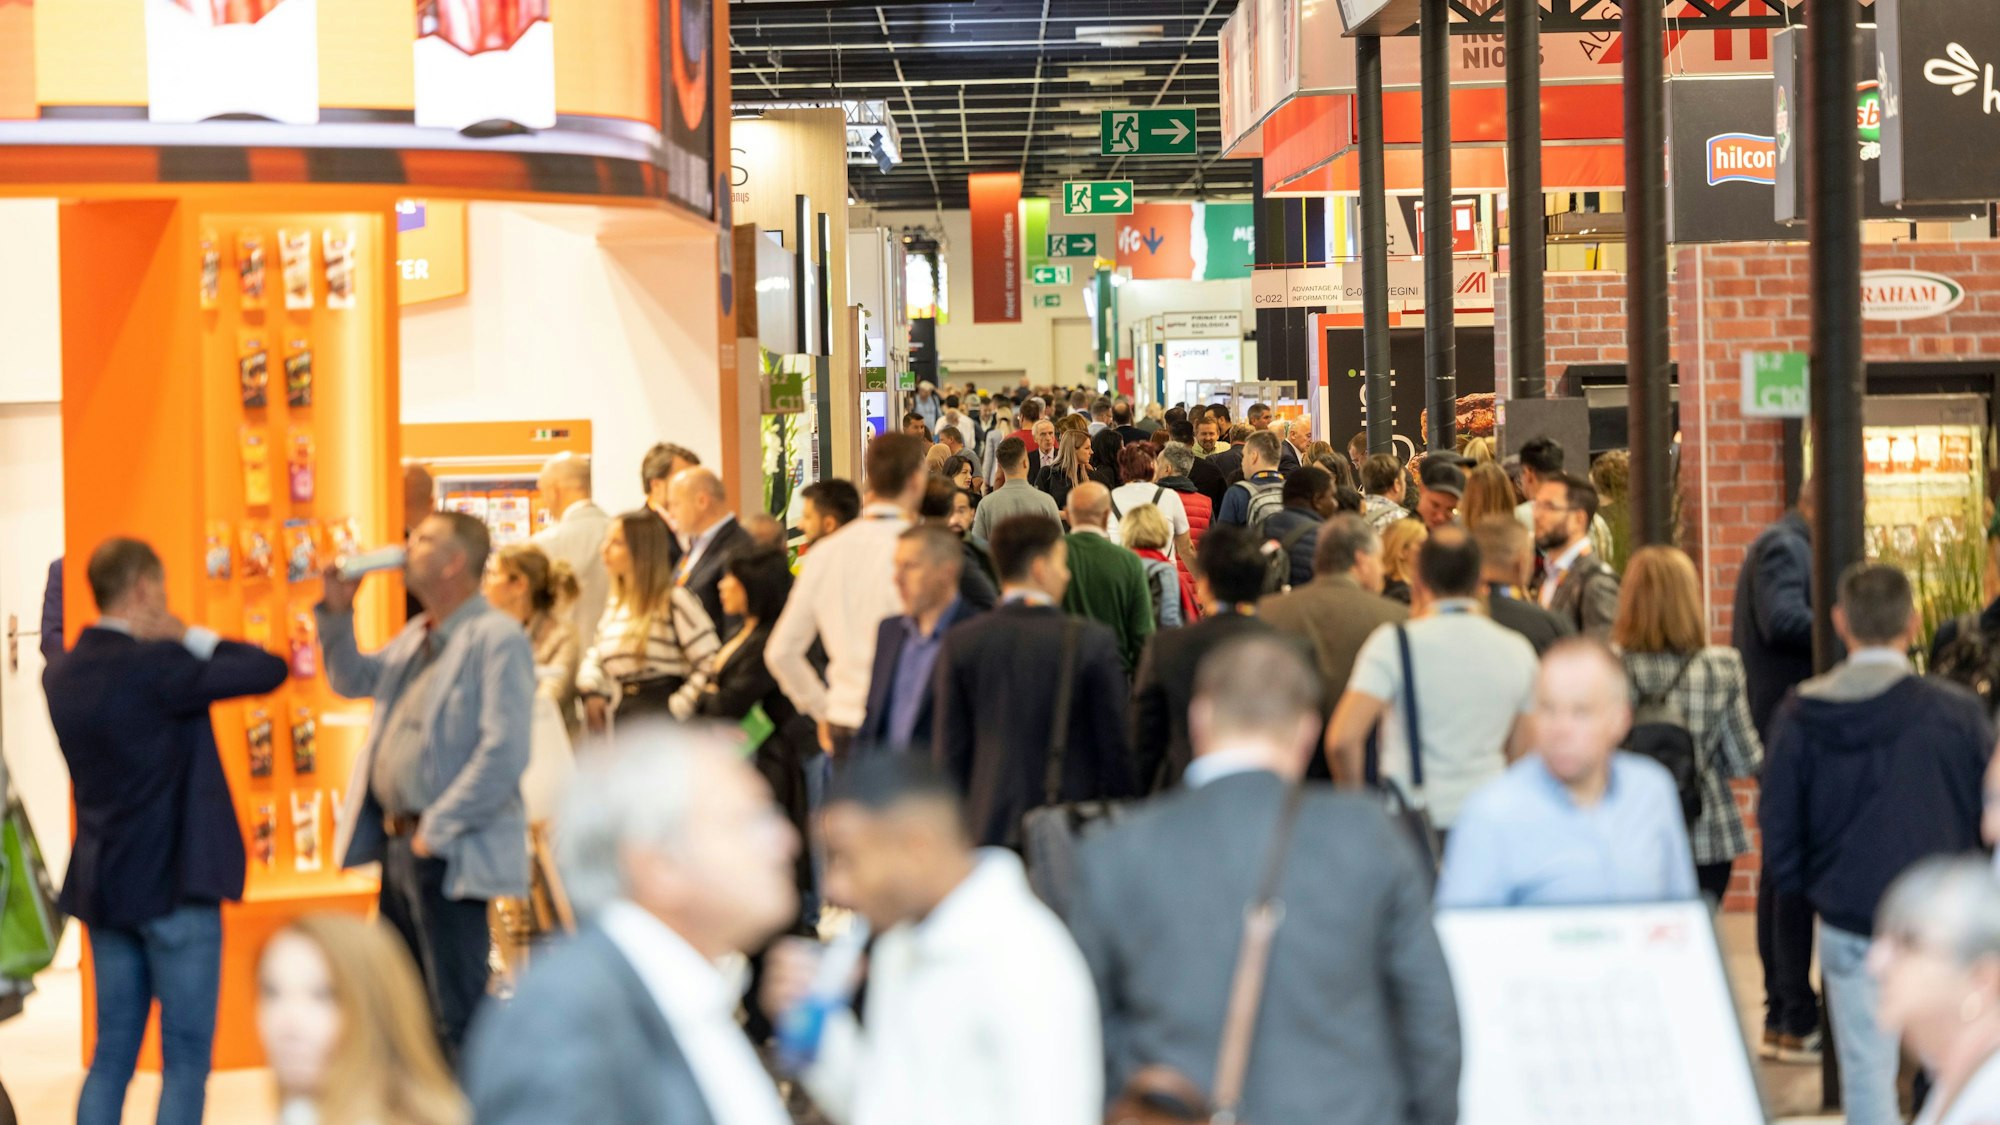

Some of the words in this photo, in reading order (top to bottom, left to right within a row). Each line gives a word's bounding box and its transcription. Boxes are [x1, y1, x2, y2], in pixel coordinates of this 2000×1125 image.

[396, 259, 429, 280] ER
[1292, 285, 1331, 293] ADVANTAGE
[1256, 295, 1282, 303] C-022
